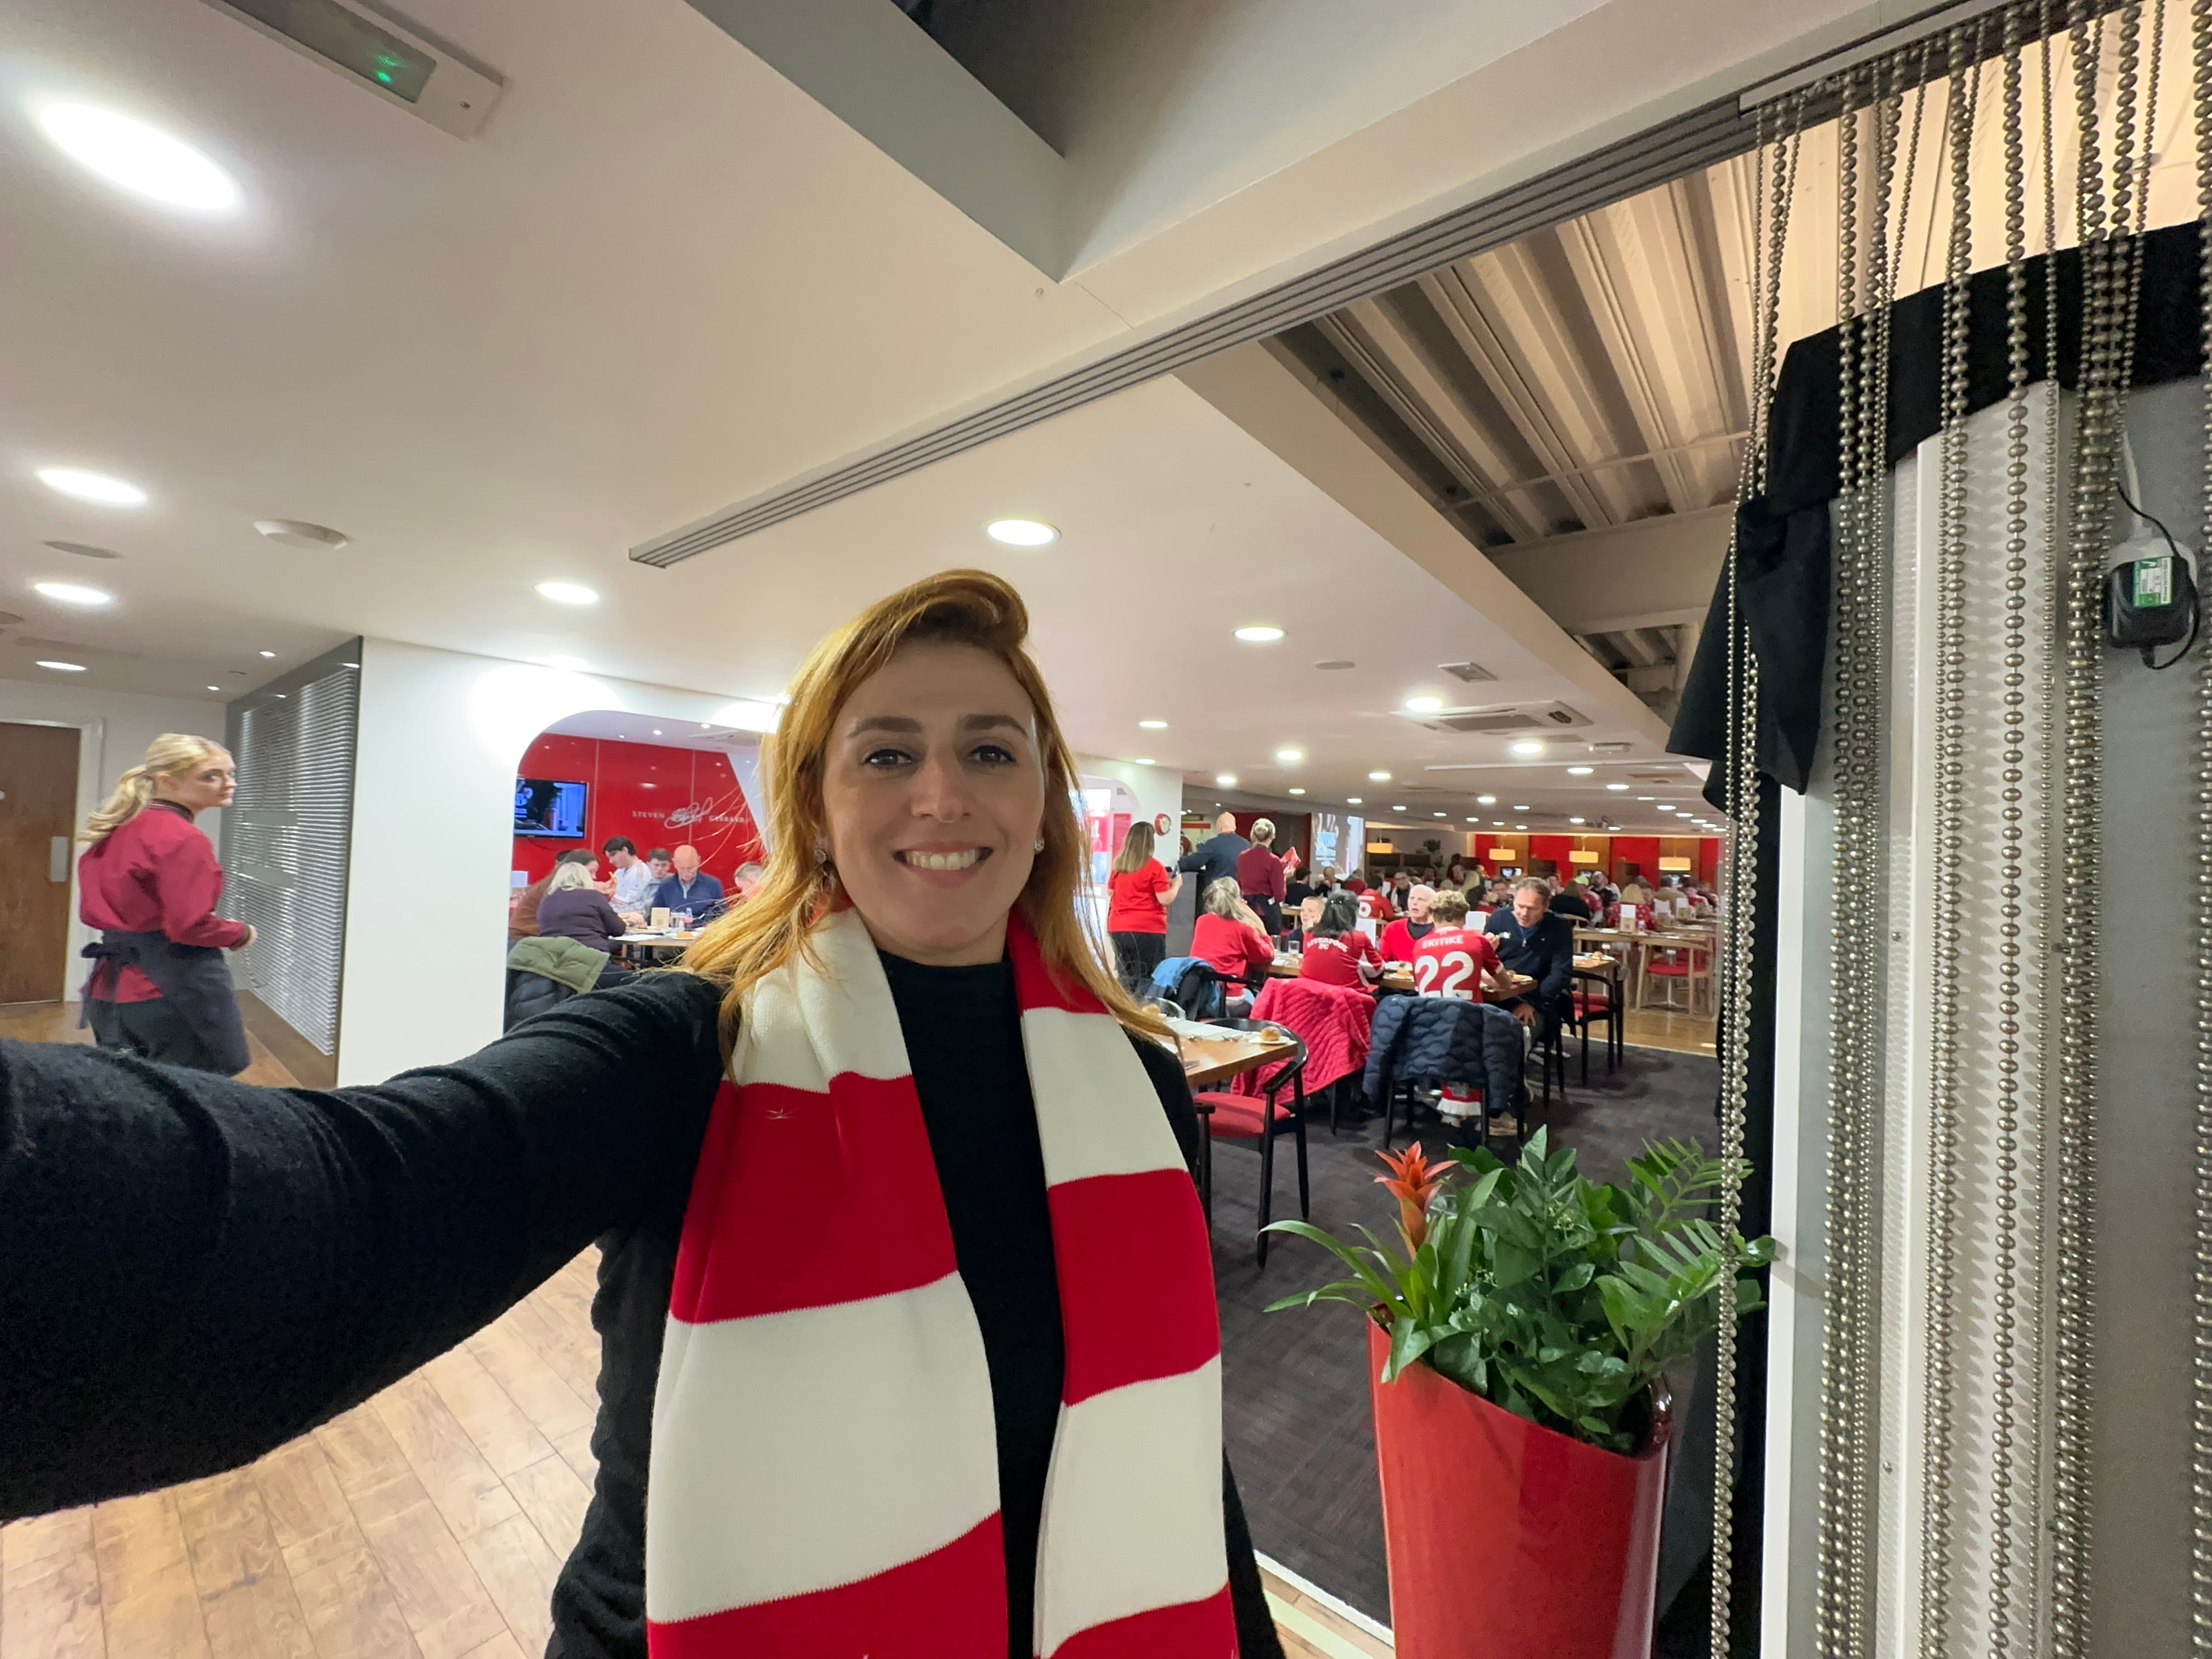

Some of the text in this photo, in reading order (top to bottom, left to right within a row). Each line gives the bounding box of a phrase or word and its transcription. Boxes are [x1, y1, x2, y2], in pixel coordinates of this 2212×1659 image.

[632, 810, 665, 819] STEVEN
[1307, 937, 1348, 952] LIVERPOOL
[1421, 934, 1464, 949] EKITIKE
[1414, 951, 1474, 1000] 22
